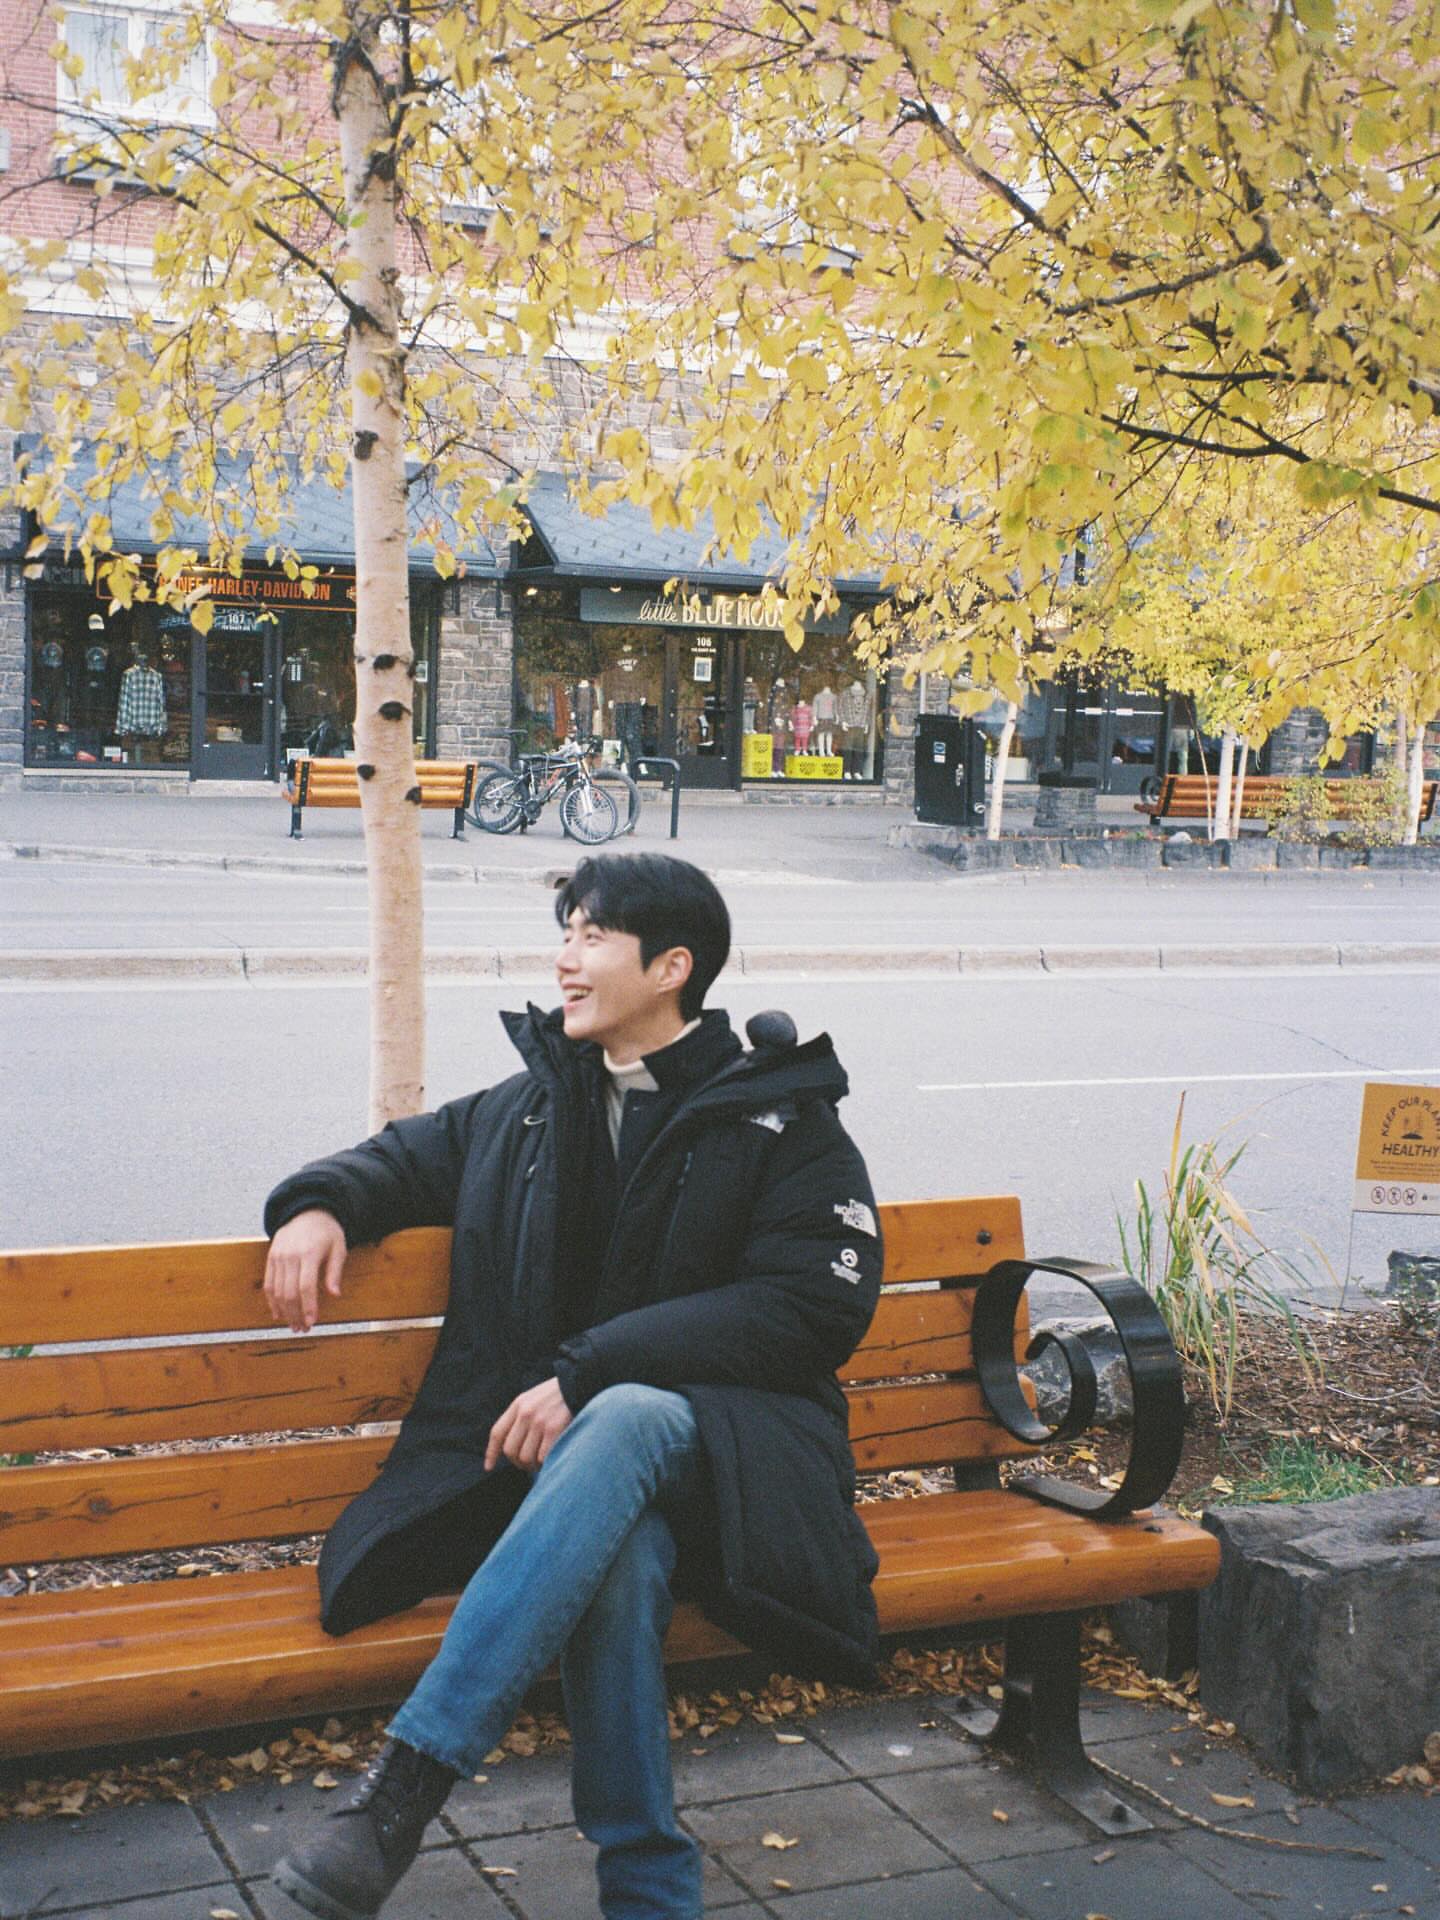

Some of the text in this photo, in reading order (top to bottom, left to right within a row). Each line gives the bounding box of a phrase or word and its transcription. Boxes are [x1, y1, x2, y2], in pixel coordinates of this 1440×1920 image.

[208, 577, 331, 601] HARLEY-DAVIDON
[637, 595, 678, 623] little
[682, 599, 735, 625] BLUE
[1381, 1106, 1396, 1136] KEEP
[1398, 1096, 1419, 1109] OUR
[1381, 1143, 1440, 1158] HEALTHY
